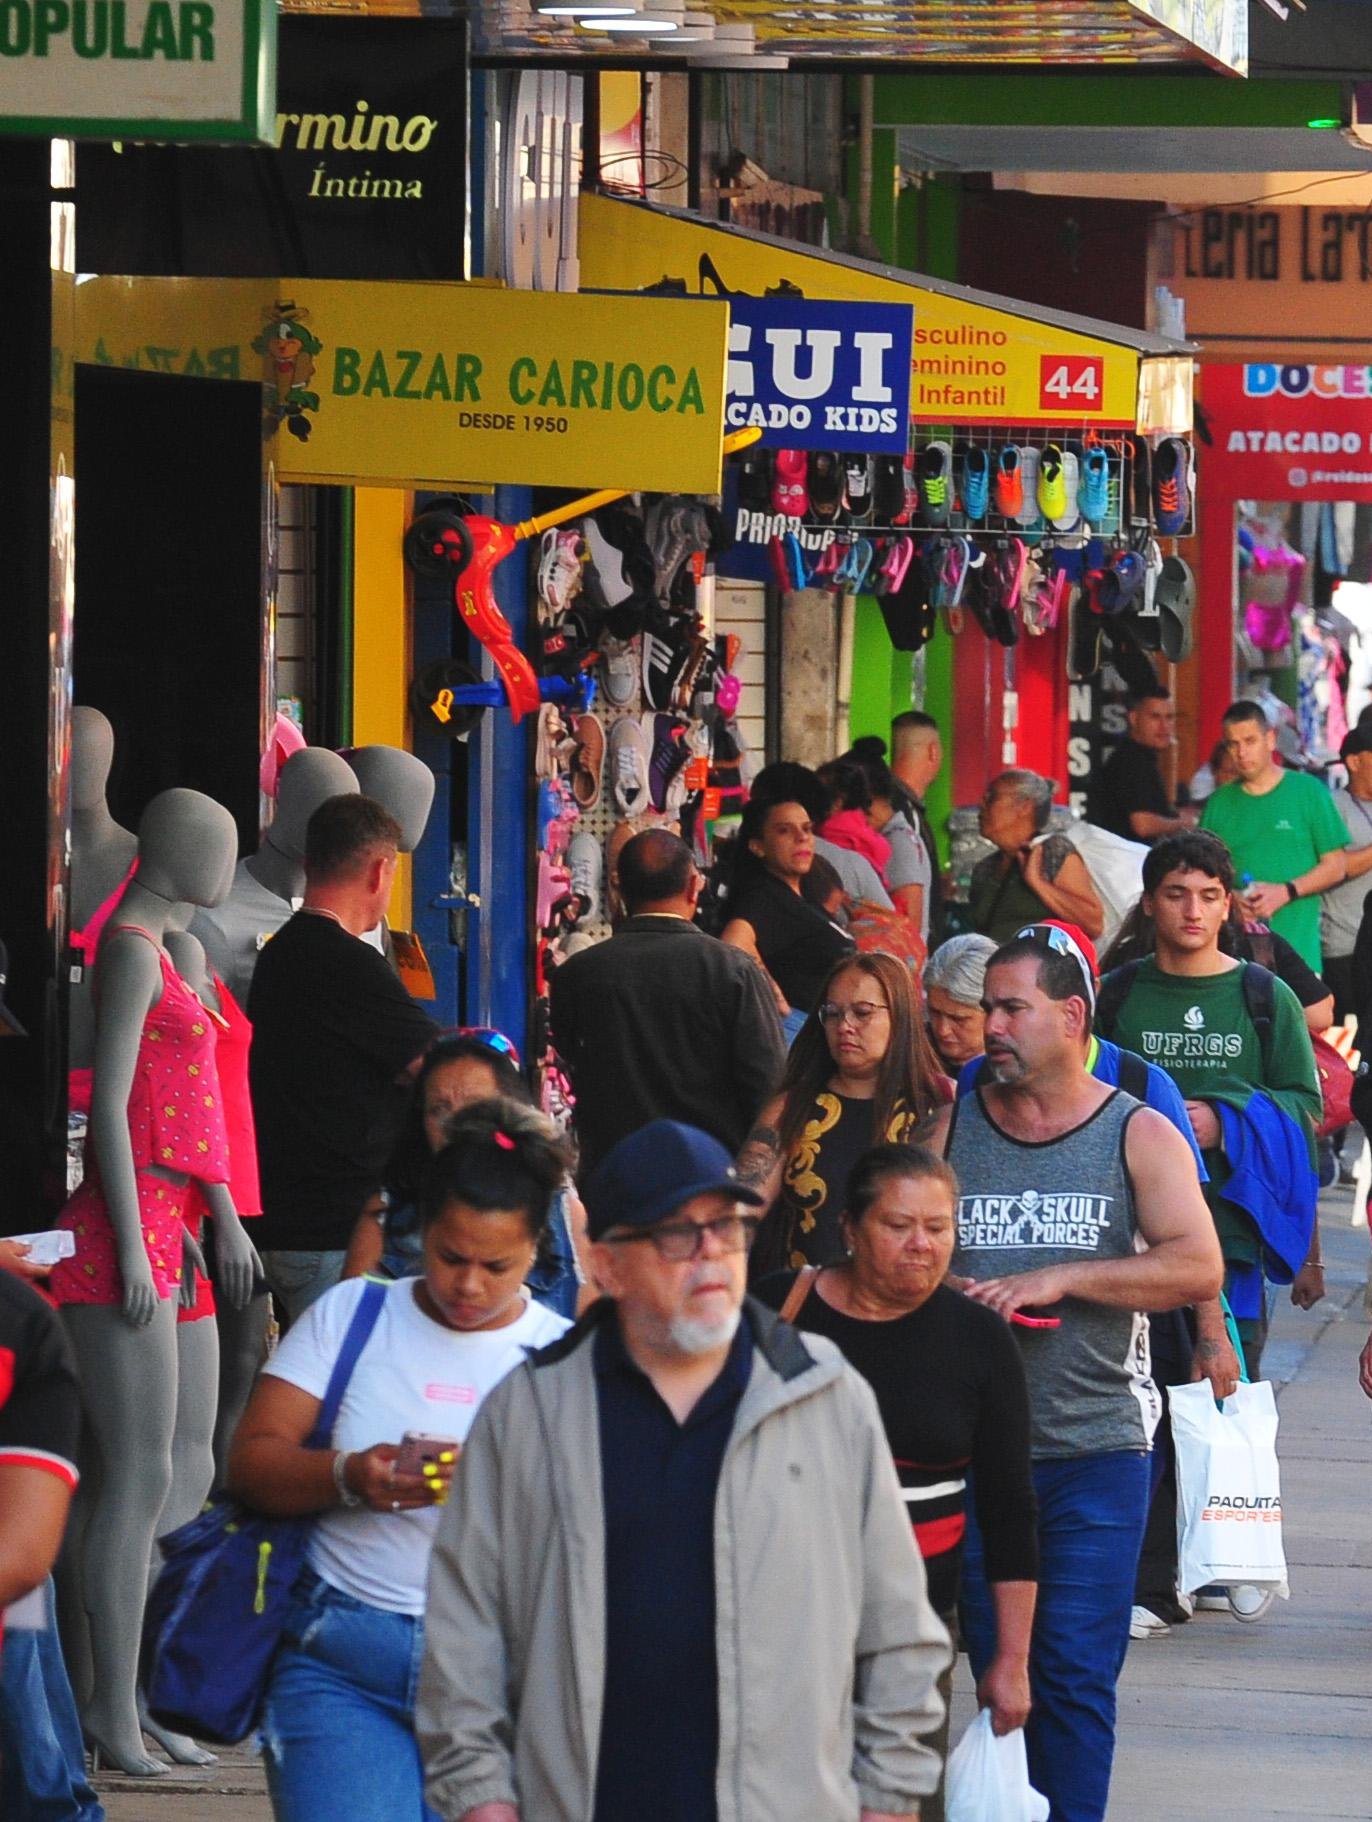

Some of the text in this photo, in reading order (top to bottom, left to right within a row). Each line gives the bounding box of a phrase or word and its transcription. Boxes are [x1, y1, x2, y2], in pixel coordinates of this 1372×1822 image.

[0, 0, 214, 61] OPULAR
[309, 161, 423, 199] Íntima
[914, 325, 1007, 346] sculino
[332, 346, 705, 415] BAZAR CARIOCA
[1044, 366, 1100, 400] 44
[919, 384, 1006, 406] Infantil
[459, 412, 568, 433] DESDE 1950
[724, 402, 898, 433] CADO KIDS
[1227, 430, 1361, 454] ATACADO
[1141, 1031, 1243, 1058] UFRGS
[1153, 1058, 1228, 1069] FISIOTERAPIA
[958, 1196, 1111, 1228] LACK SKULL
[958, 1223, 1024, 1246] SPECIAL
[1208, 1495, 1281, 1509] PAQUITA
